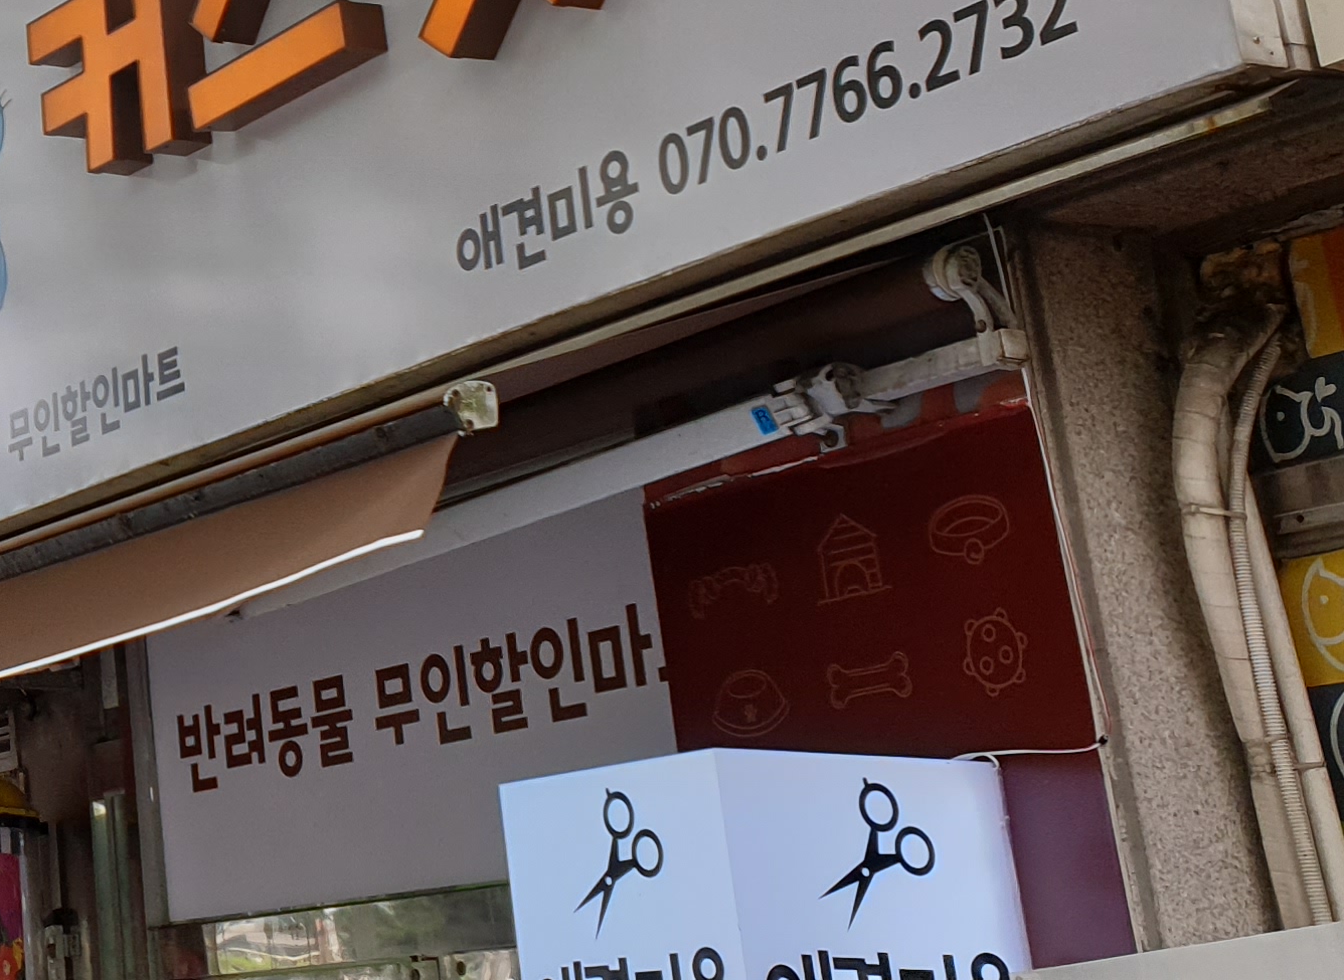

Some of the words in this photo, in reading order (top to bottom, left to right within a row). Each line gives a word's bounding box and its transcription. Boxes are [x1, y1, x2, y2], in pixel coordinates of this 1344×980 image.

[456, 149, 639, 271] 애견미용
[8, 345, 186, 462] 무인할인마트
[176, 674, 354, 793] 반려동물
[374, 603, 670, 746] 무인할인마
